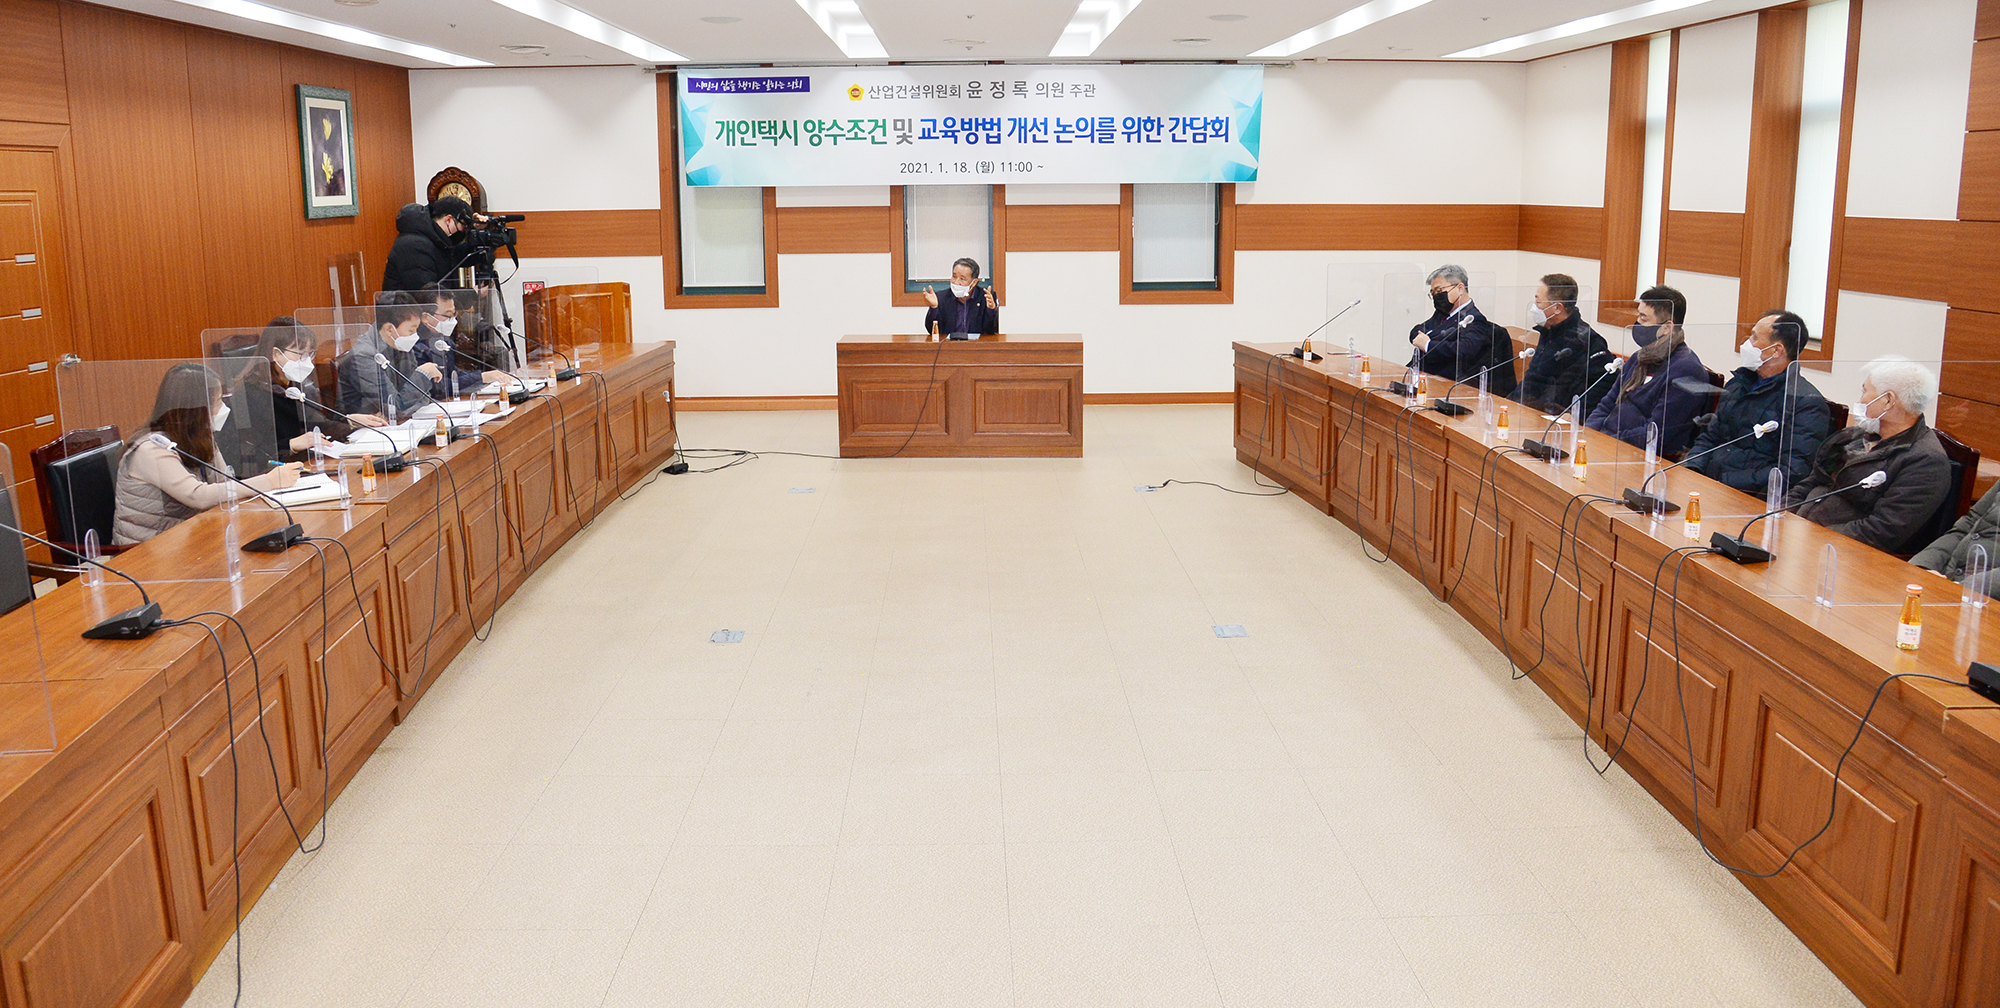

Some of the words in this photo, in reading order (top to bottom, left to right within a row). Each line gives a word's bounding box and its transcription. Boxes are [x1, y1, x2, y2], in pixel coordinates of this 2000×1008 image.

[868, 83, 962, 100] 산업건설위원회
[1035, 82, 1064, 99] 의원
[1069, 83, 1097, 98] 주관
[714, 119, 799, 147] 개인택시
[803, 118, 888, 147] 양수조건
[893, 118, 914, 146] 및
[917, 116, 1002, 146] 교육방법
[1007, 116, 1050, 144] 개선
[1053, 116, 1118, 144] 논의를
[1121, 115, 1165, 143] 위한
[1168, 115, 1230, 144] 간담회
[900, 162, 934, 174] 2021.
[938, 162, 949, 174] 1.
[953, 162, 971, 174] 18.
[975, 160, 995, 174] (월)
[1000, 161, 1033, 173] 11:00
